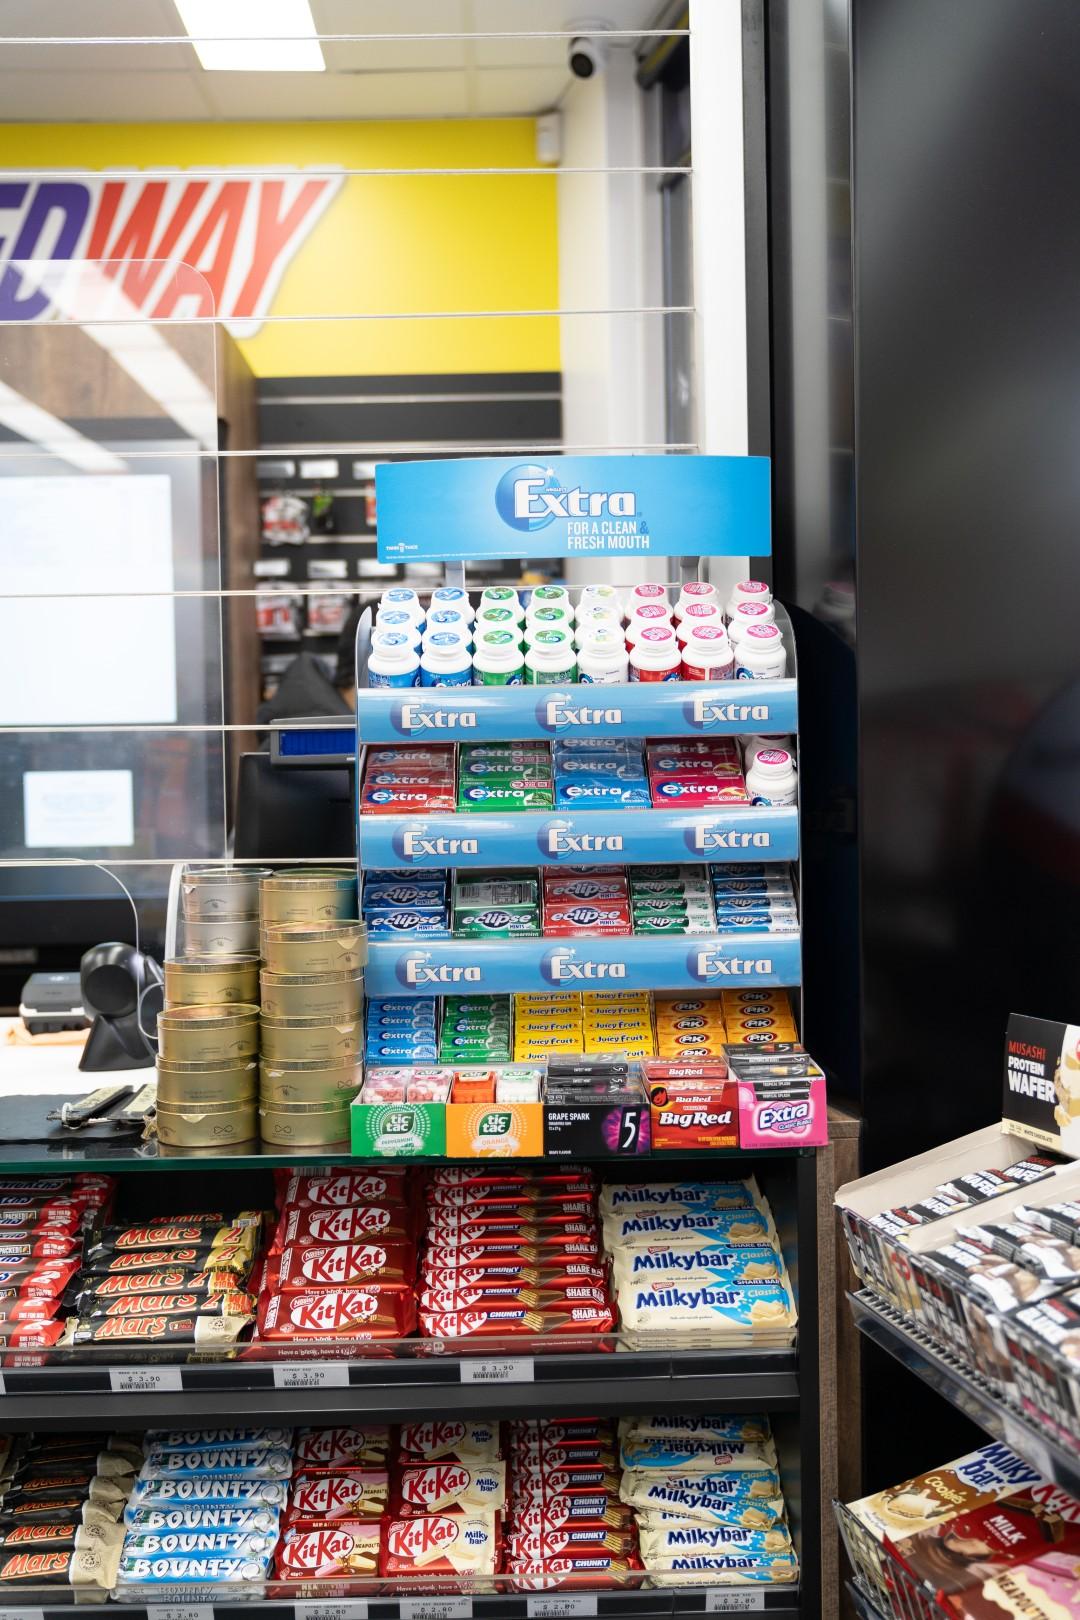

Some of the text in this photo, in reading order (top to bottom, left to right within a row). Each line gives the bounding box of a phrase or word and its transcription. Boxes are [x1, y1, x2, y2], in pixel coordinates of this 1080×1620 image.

[513, 478, 636, 518] Extra
[568, 521, 649, 534] FOR A CLEAN &
[568, 536, 649, 549] FRESH MOUTH
[401, 703, 477, 728] Extra
[546, 701, 622, 725] Extra
[694, 694, 769, 721] Extra
[470, 763, 524, 773] extra
[563, 760, 616, 772] extra
[659, 759, 712, 768] extra
[376, 775, 429, 784] extra
[662, 784, 718, 794] extra
[372, 789, 427, 803] extra
[469, 789, 524, 798] extra
[566, 785, 621, 798] extra
[403, 831, 478, 855] Extra
[548, 828, 623, 852] Extra
[695, 825, 769, 849] Extra
[371, 891, 439, 903] eclipse
[553, 882, 620, 896] eclipse
[372, 916, 441, 929] eclipse
[462, 914, 531, 928] eclipse
[551, 910, 620, 922] eclipse
[637, 917, 687, 926] eclipse
[719, 916, 769, 925] eclipse
[406, 959, 481, 983] Extra
[551, 955, 625, 979] Extra
[697, 952, 772, 976] Extra
[1008, 1041, 1045, 1060] MUSASHI
[1008, 1056, 1045, 1076] PROTEIN
[1008, 1070, 1055, 1103] WAFER
[392, 1114, 409, 1123] tic
[488, 1115, 506, 1124] tic
[659, 1111, 731, 1127] Big Red
[760, 1103, 807, 1128] Extra
[386, 1123, 409, 1132] tac
[483, 1124, 505, 1133] tac
[622, 1112, 636, 1148] 5
[317, 1176, 384, 1204] KitKat
[441, 1186, 487, 1206] KitKat
[612, 1188, 707, 1206] Milkybar
[318, 1208, 386, 1240] KitKat
[435, 1206, 484, 1226] KitKat
[622, 1215, 719, 1235] Milkybar
[116, 1227, 201, 1246] Mars
[434, 1226, 484, 1245] KitKat
[433, 1246, 484, 1266] KitKat
[565, 1244, 589, 1252] SHARE
[741, 1251, 773, 1259] Classic
[109, 1250, 196, 1269] Mars
[312, 1246, 384, 1281] KitKat
[633, 1251, 734, 1272] Milkybar
[432, 1268, 483, 1289] KitKat
[567, 1266, 589, 1274] SHARE
[96, 1273, 184, 1294] Mars
[188, 1273, 209, 1288] 2
[201, 1294, 221, 1310] 2
[429, 1289, 483, 1311] KitKat
[636, 1288, 740, 1309] Milkybar
[748, 1288, 781, 1297] Classic
[106, 1294, 198, 1315] Mars
[300, 1293, 375, 1328] KitKat
[572, 1309, 598, 1319] SHARE
[94, 1317, 167, 1337] Mars
[433, 1313, 487, 1335] KitKat
[651, 1417, 731, 1431] Milkybar
[407, 1421, 465, 1450] KitKat
[472, 1430, 493, 1440] Milky
[303, 1430, 361, 1461] KitKat
[169, 1450, 268, 1469] BOUNTY
[978, 1443, 1042, 1484] Milky
[741, 1472, 770, 1480] Classic
[959, 1459, 1004, 1486] bar
[159, 1480, 261, 1499] BOUNTY
[408, 1469, 466, 1504] KitKat
[476, 1478, 499, 1489] Milky
[480, 1484, 495, 1492] bar
[300, 1478, 360, 1512] KitKat
[648, 1486, 733, 1511] Milkybar
[149, 1509, 253, 1528] BOUNTY
[517, 1506, 569, 1533] KitKat
[5, 1525, 75, 1543] Mars
[394, 1521, 454, 1557] KitKat
[465, 1530, 488, 1541] Milky
[572, 1532, 604, 1540] CHUNKY
[668, 1528, 752, 1547] Milkybar
[989, 1515, 1026, 1545] MILK
[143, 1533, 248, 1552] BOUNTY
[289, 1532, 350, 1568] KitKat
[469, 1537, 484, 1545] bar
[516, 1532, 568, 1560] KitKat
[1, 1552, 70, 1577] Mars
[133, 1558, 241, 1578] BOUNTY
